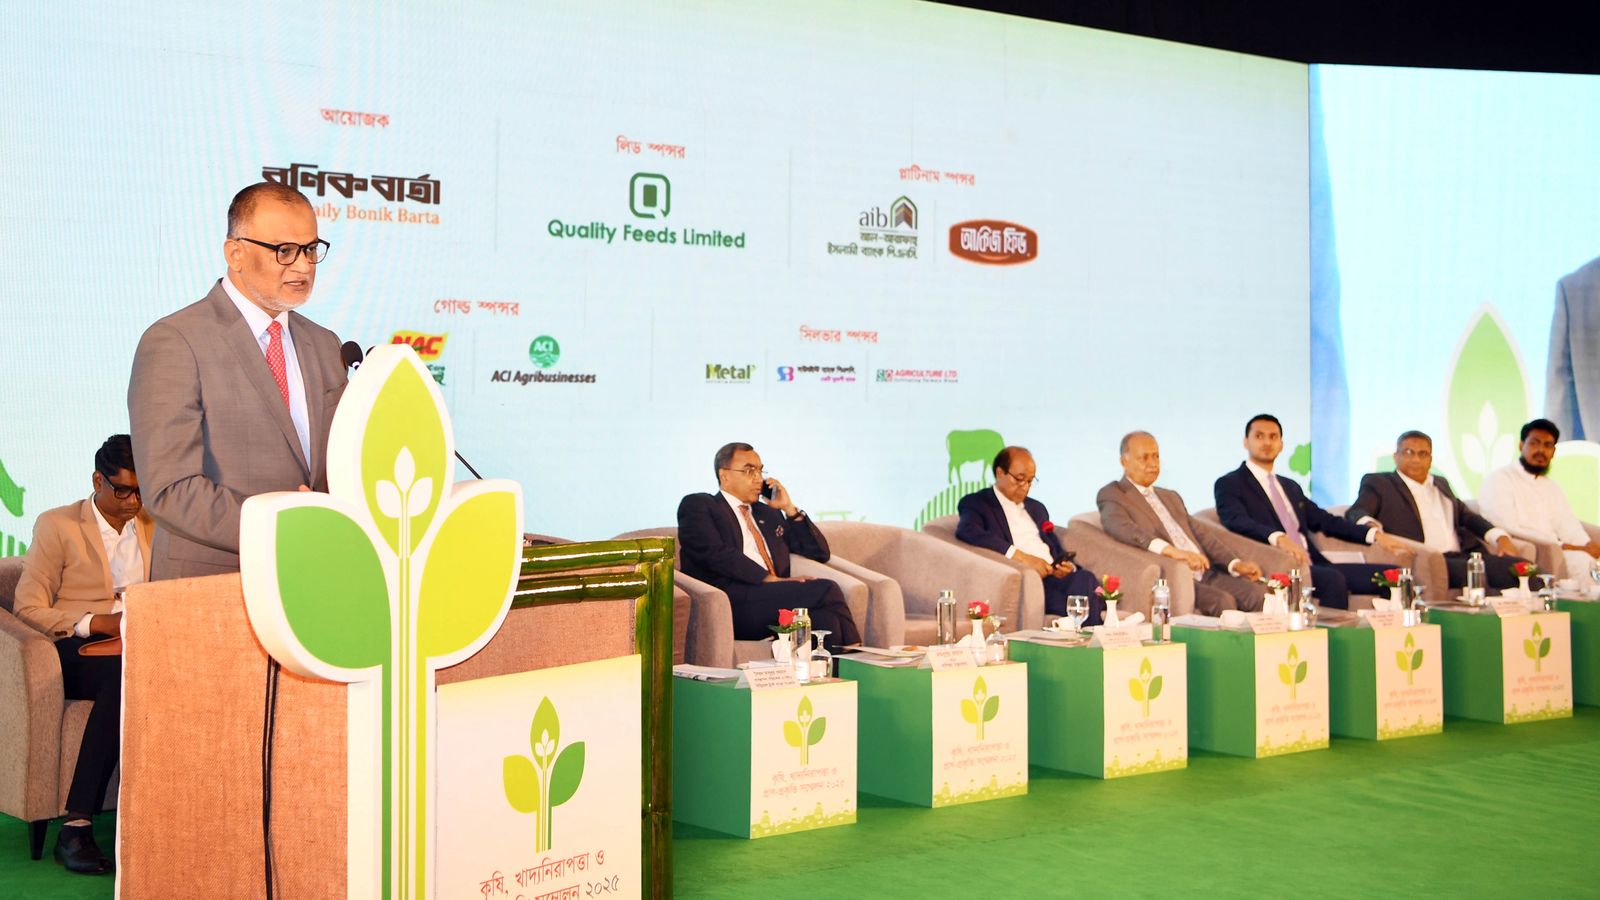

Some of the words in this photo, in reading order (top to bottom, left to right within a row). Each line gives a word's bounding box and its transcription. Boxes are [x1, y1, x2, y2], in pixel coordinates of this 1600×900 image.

[320, 108, 390, 127] আয়োজক
[616, 135, 642, 154] লিড
[313, 203, 341, 221] aily
[346, 204, 393, 221] Bonik
[397, 207, 440, 225] Barta
[859, 206, 888, 228] aib
[547, 219, 617, 244] Quality
[623, 224, 677, 244] Feeds
[683, 228, 745, 248] Limited
[960, 226, 1001, 252] আকিজ
[1003, 227, 1028, 254] ফিড
[434, 299, 472, 314] গোল্ড
[799, 325, 841, 342] সিলভার
[534, 341, 554, 352] ACI
[491, 370, 512, 382] ACI
[513, 370, 597, 386] Agribusinesses
[706, 364, 751, 380] Metal
[480, 870, 509, 900] কৃষি,
[515, 852, 590, 888] খাদ্যনিরাপত্তা
[595, 850, 606, 865] ও
[585, 874, 620, 898] ২০২৫
